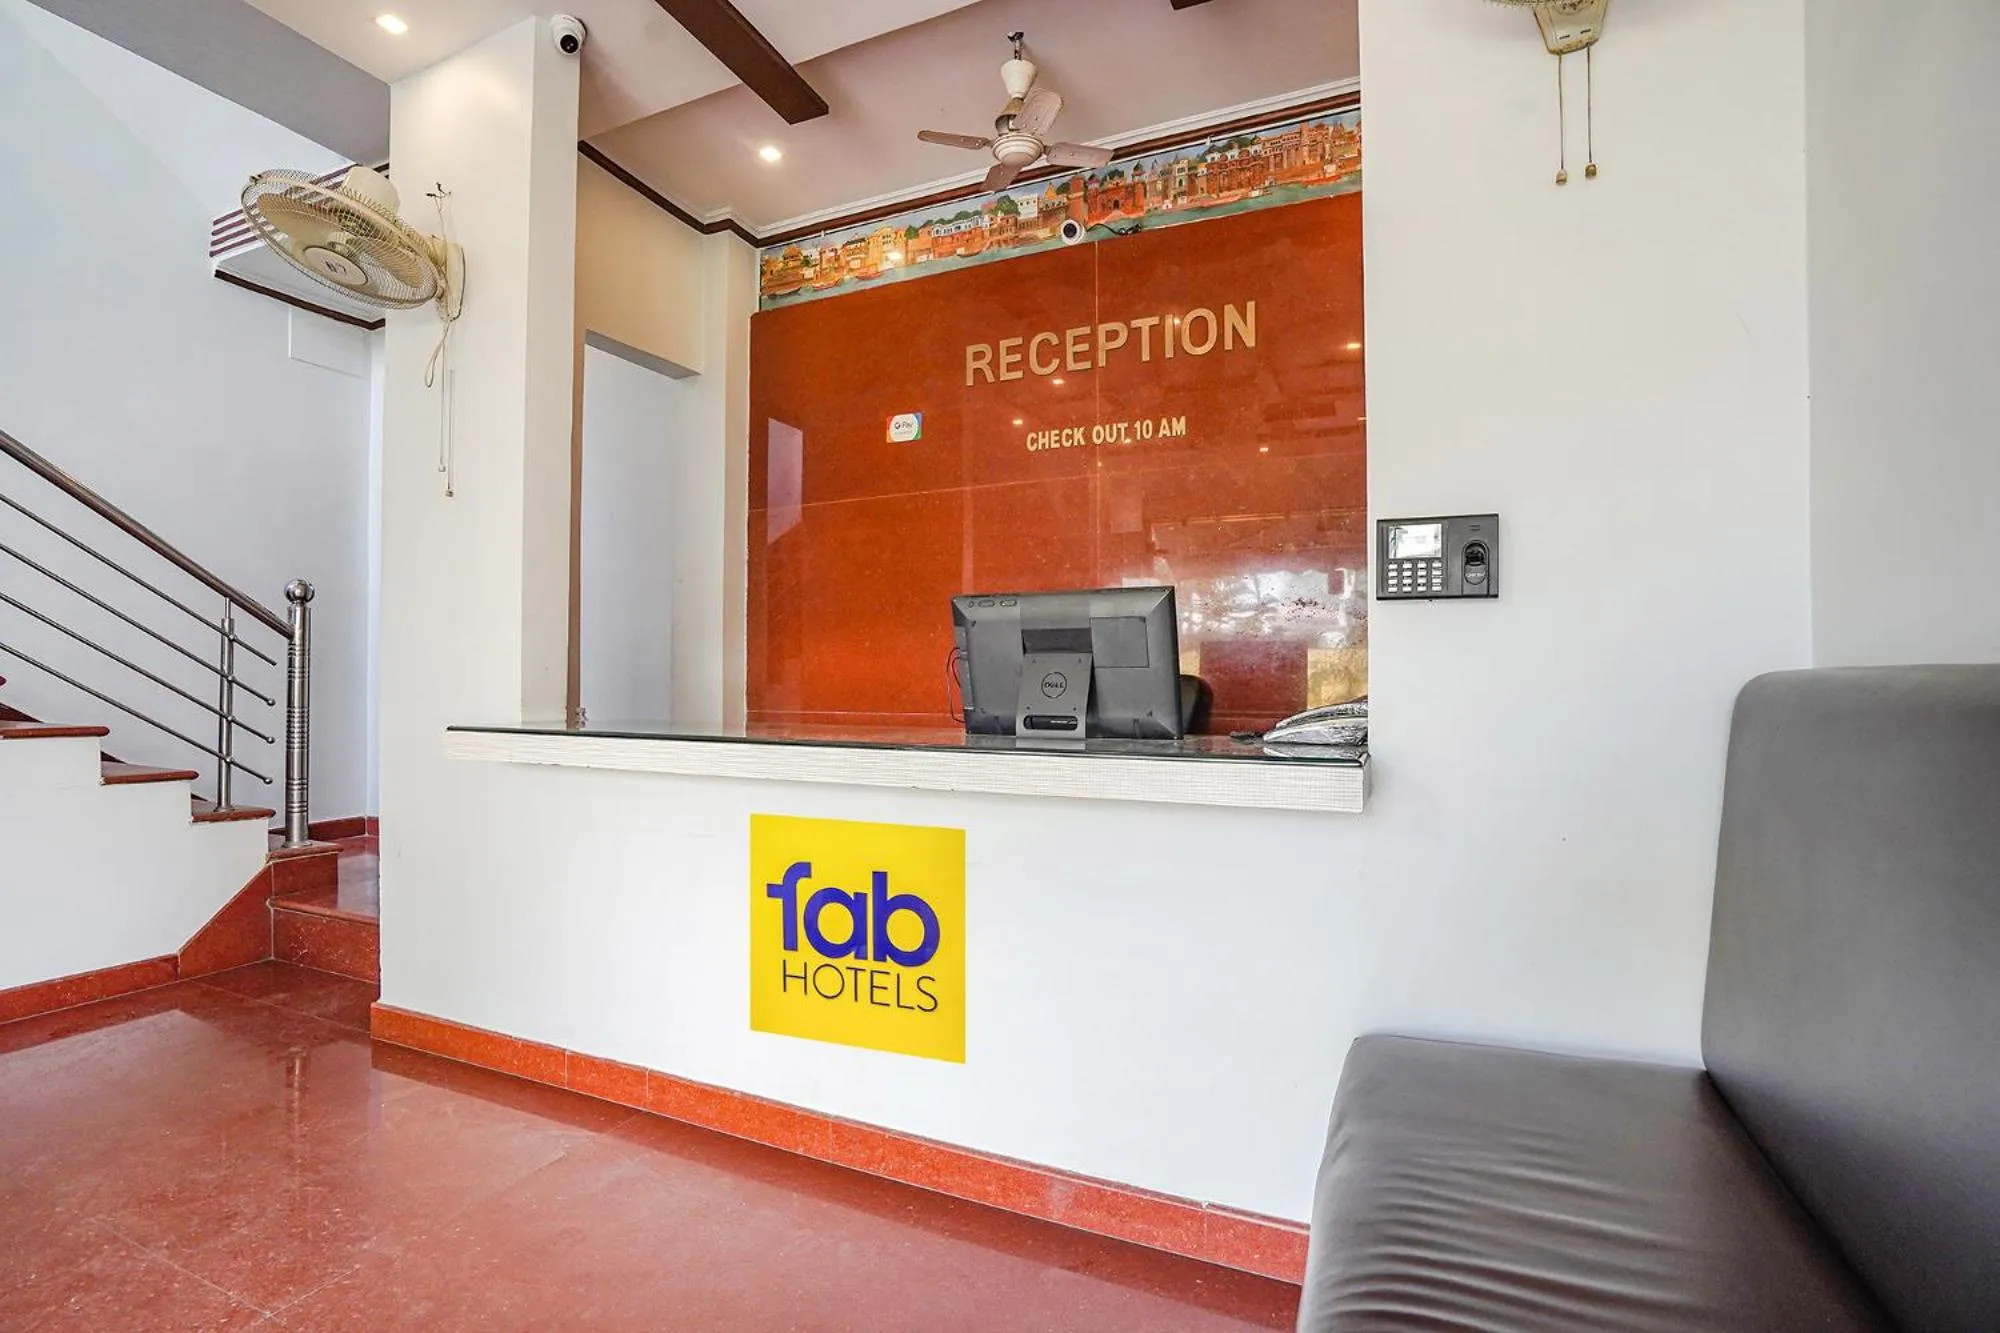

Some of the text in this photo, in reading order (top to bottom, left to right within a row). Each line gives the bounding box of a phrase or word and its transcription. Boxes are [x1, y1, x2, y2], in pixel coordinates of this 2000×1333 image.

[965, 300, 1257, 387] RECEPTION
[1026, 416, 1187, 451] CHECK OUT 10 AM
[766, 861, 941, 967] fab
[782, 959, 938, 1013] HOTELS
